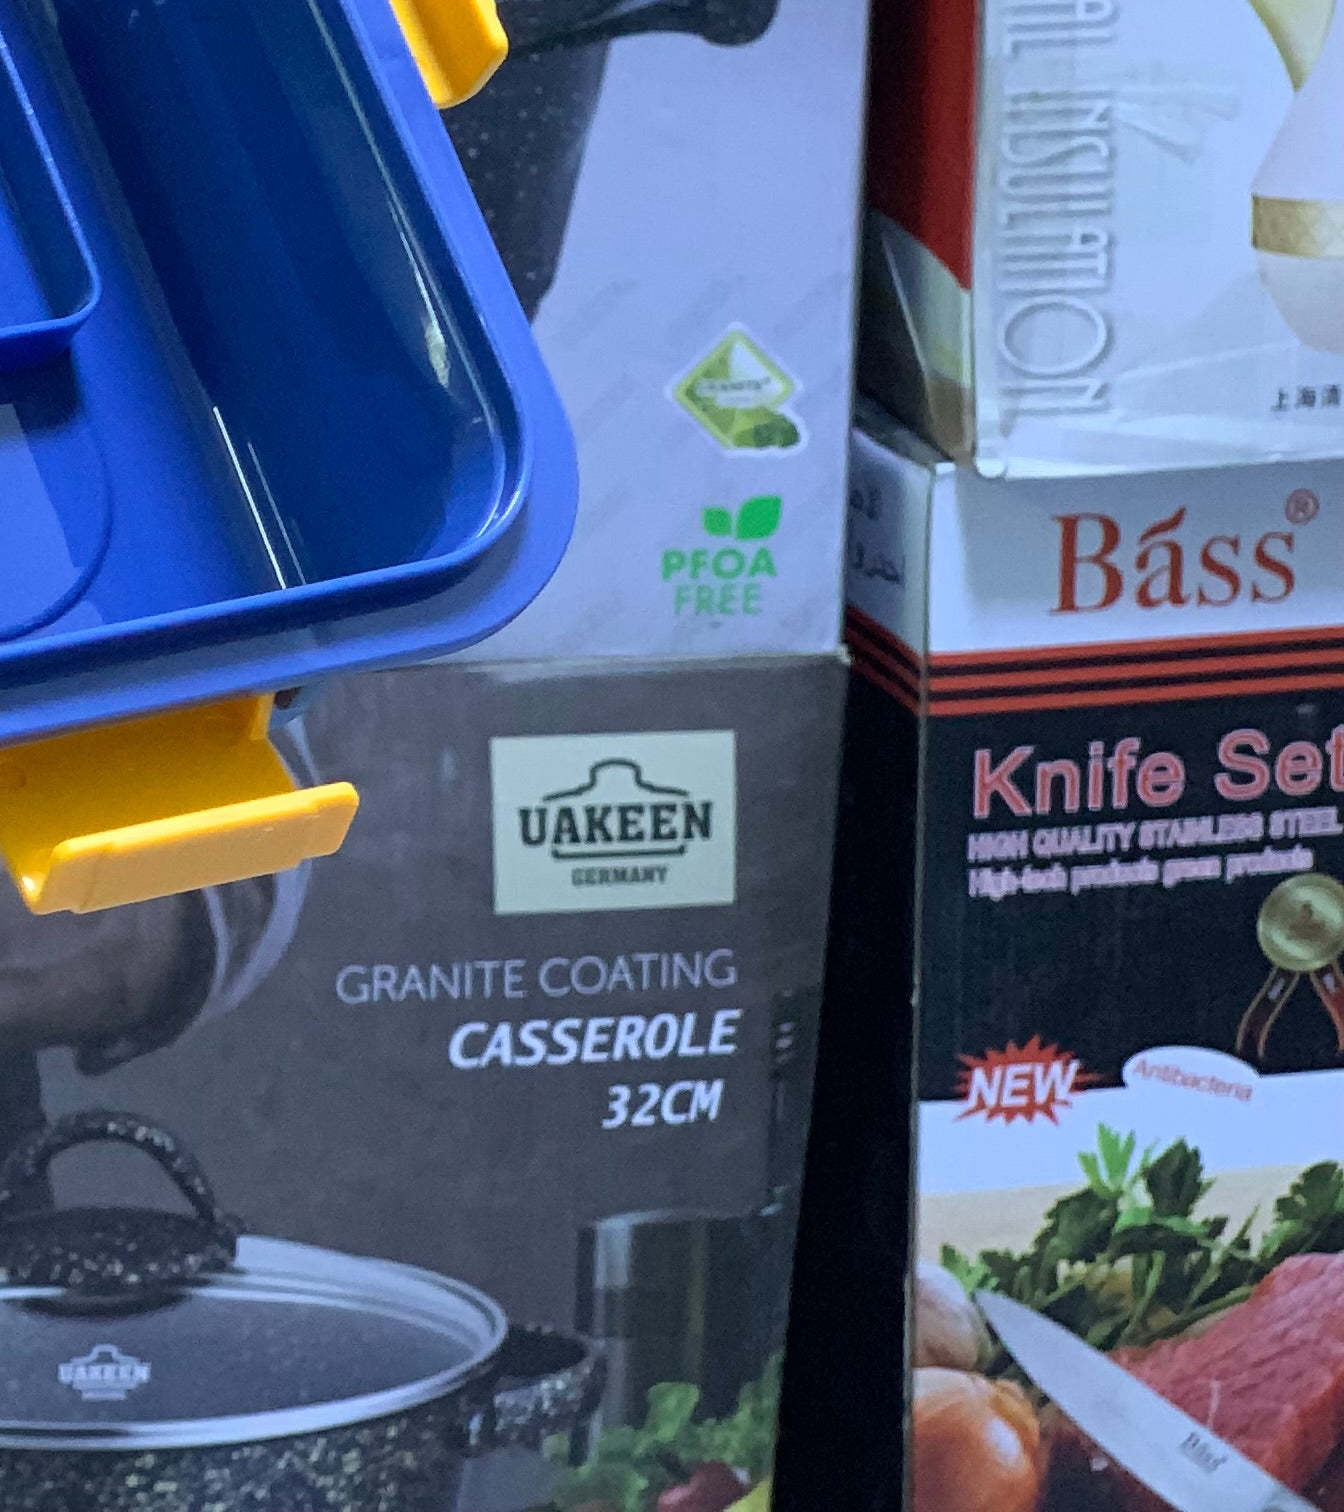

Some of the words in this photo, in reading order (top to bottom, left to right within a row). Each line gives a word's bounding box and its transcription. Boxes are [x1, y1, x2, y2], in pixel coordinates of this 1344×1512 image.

[661, 547, 777, 583] PFOA
[674, 583, 762, 616] FREE
[972, 737, 1186, 819] Knife
[1214, 724, 1344, 802] Set
[517, 801, 713, 846] UAKEEN
[967, 831, 1029, 862] HIGH
[1032, 822, 1136, 858] QUALITY
[1138, 812, 1263, 850] STAINLESS
[1268, 806, 1344, 839] STEEL
[571, 865, 669, 887] GERMANY
[335, 959, 528, 1004] GRANITE
[538, 949, 738, 996] COATING
[448, 1009, 743, 1070] CASSEROLE
[602, 1079, 725, 1130] 32CM
[966, 1059, 1080, 1111] NEW
[1132, 1059, 1253, 1102] Antibacteria
